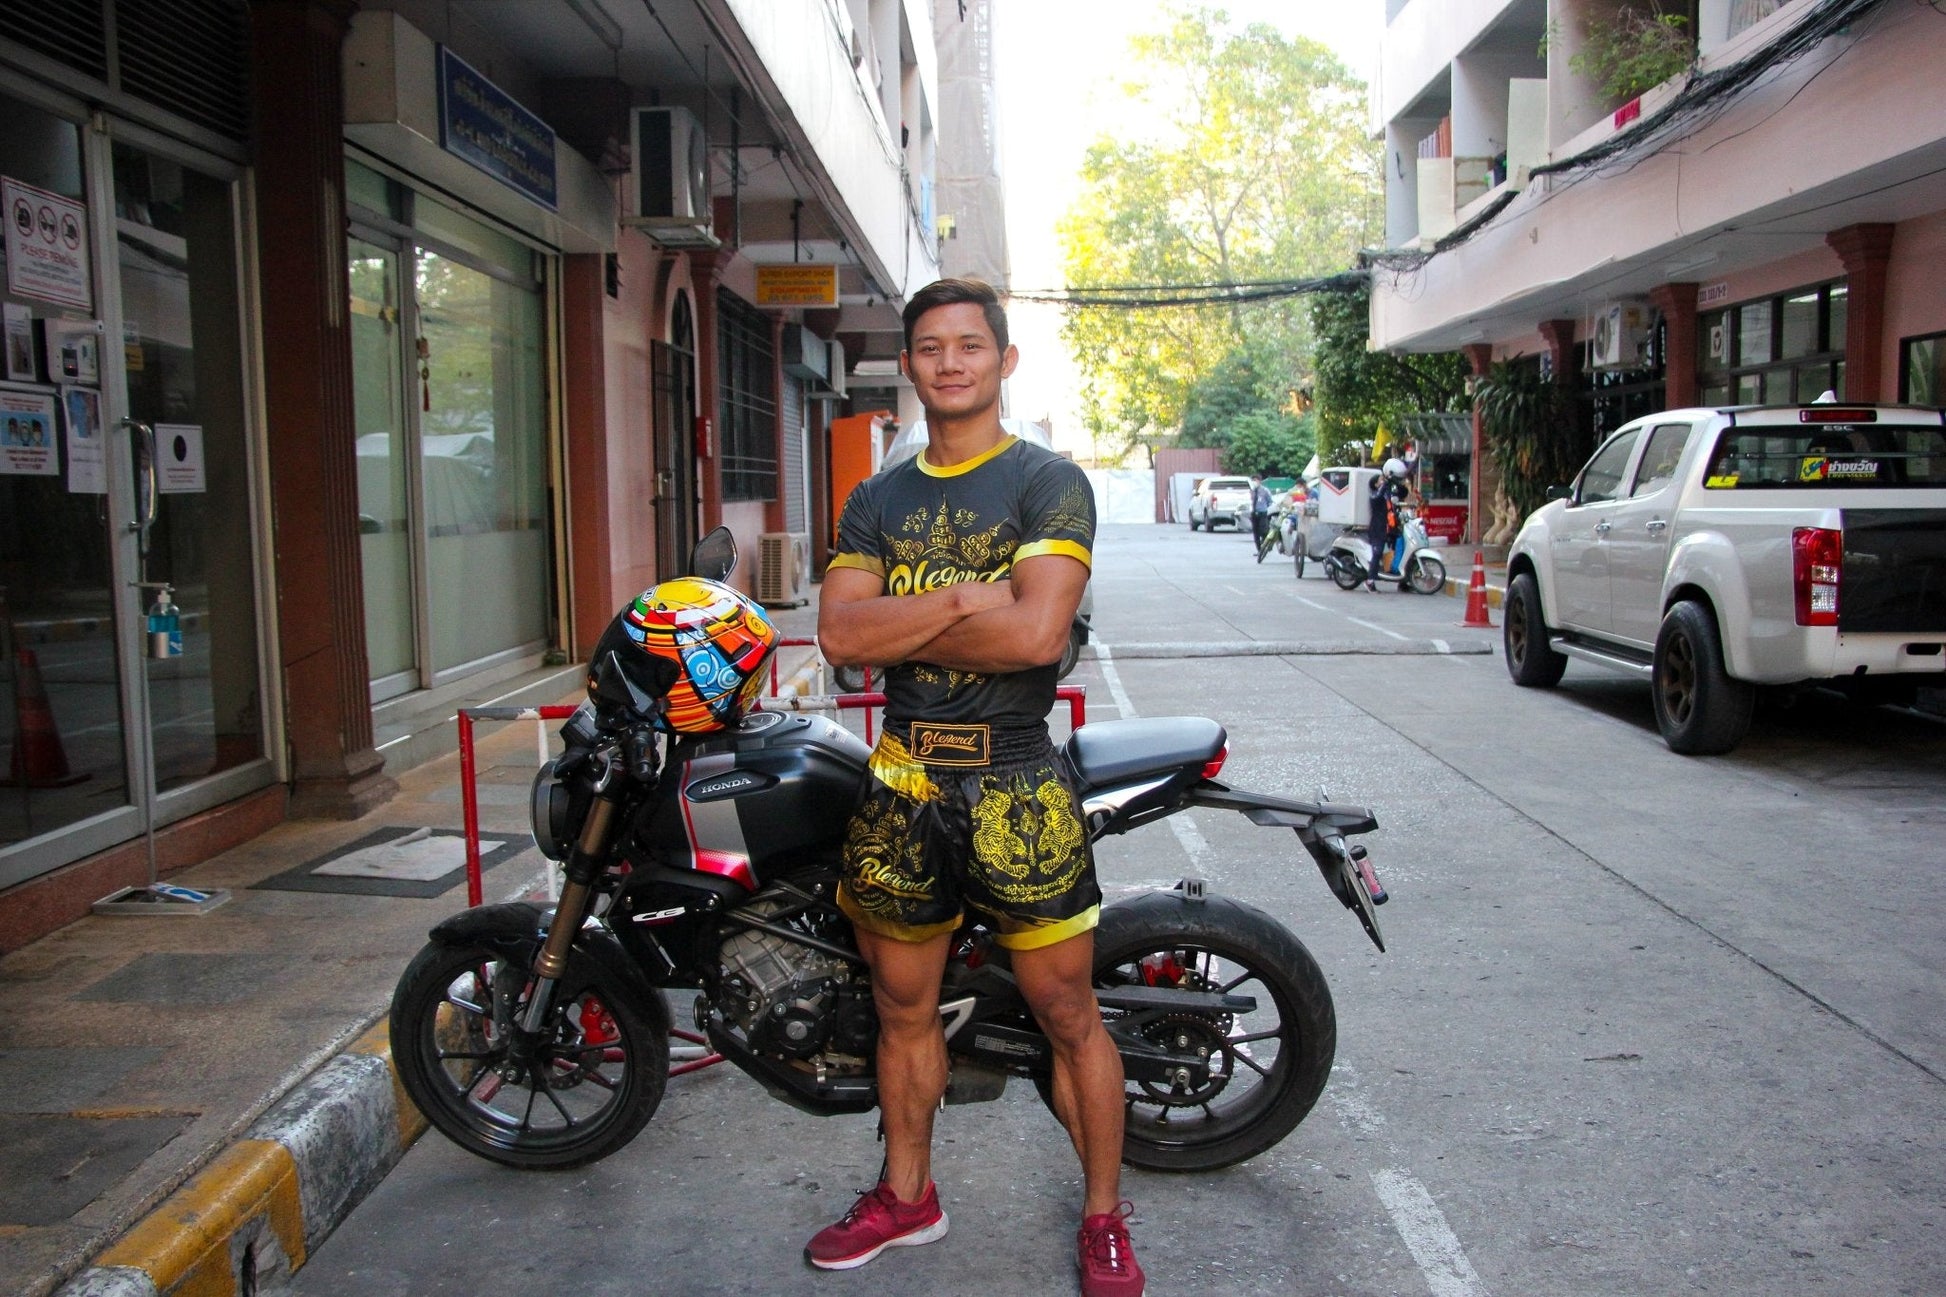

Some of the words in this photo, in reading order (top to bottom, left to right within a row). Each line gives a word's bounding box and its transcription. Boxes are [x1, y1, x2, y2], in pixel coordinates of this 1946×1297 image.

[769, 286, 823, 294] EQUIPMENT
[920, 730, 978, 755] Blegend
[701, 777, 752, 793] HONDA
[853, 857, 936, 899] Blegend
[632, 906, 686, 922] CB
